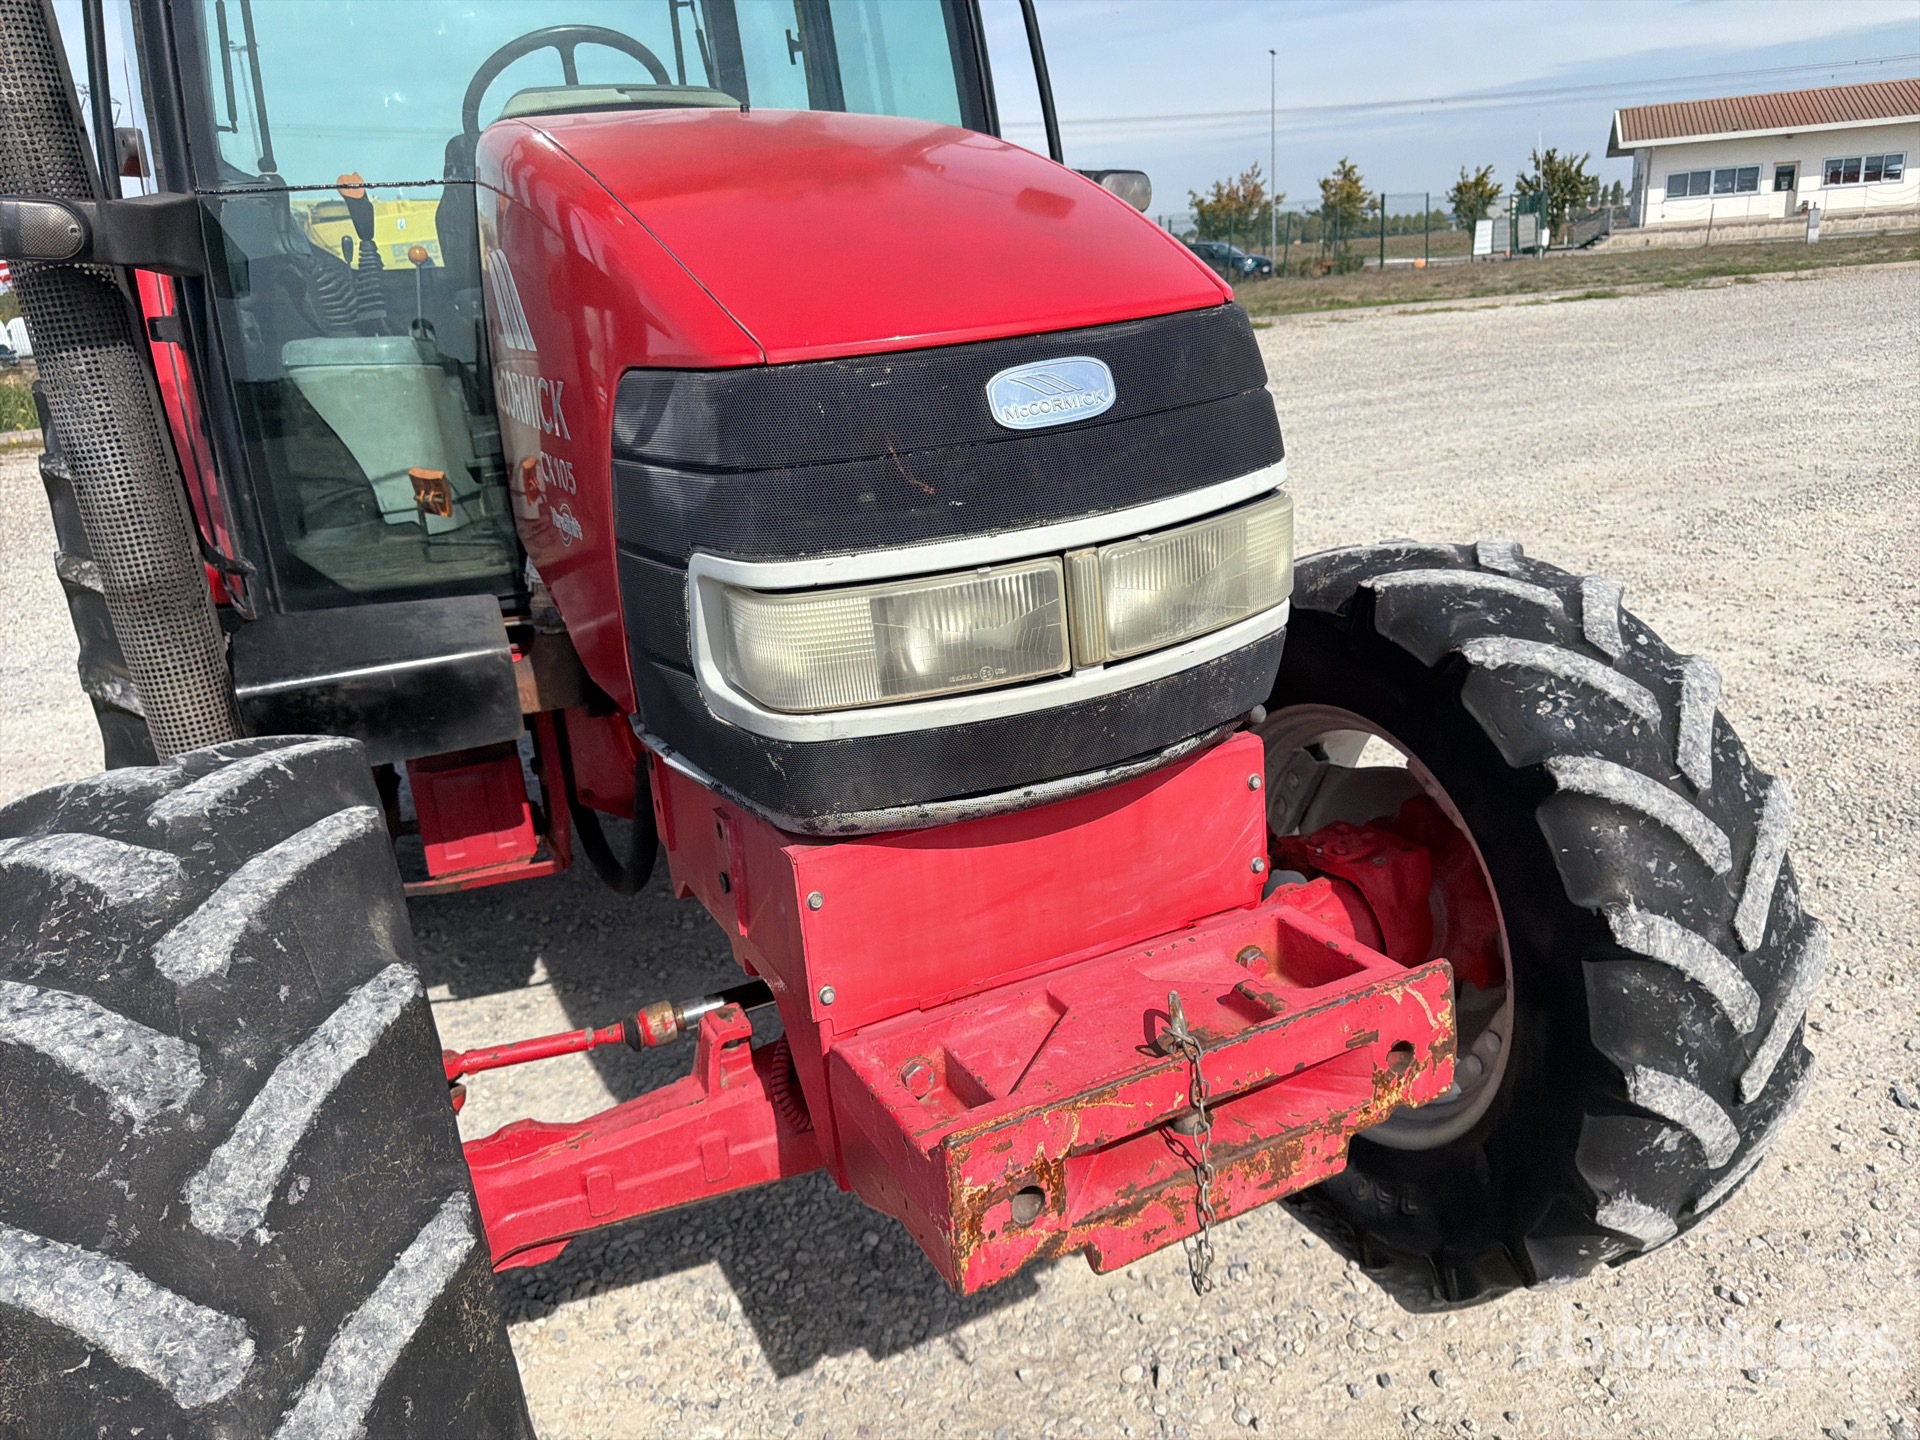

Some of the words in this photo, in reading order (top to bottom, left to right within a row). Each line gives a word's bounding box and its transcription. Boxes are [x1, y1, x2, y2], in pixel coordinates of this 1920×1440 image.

[499, 369, 571, 441] CORMICK
[1004, 391, 1107, 421] McCORMICK
[540, 450, 577, 495] CX105
